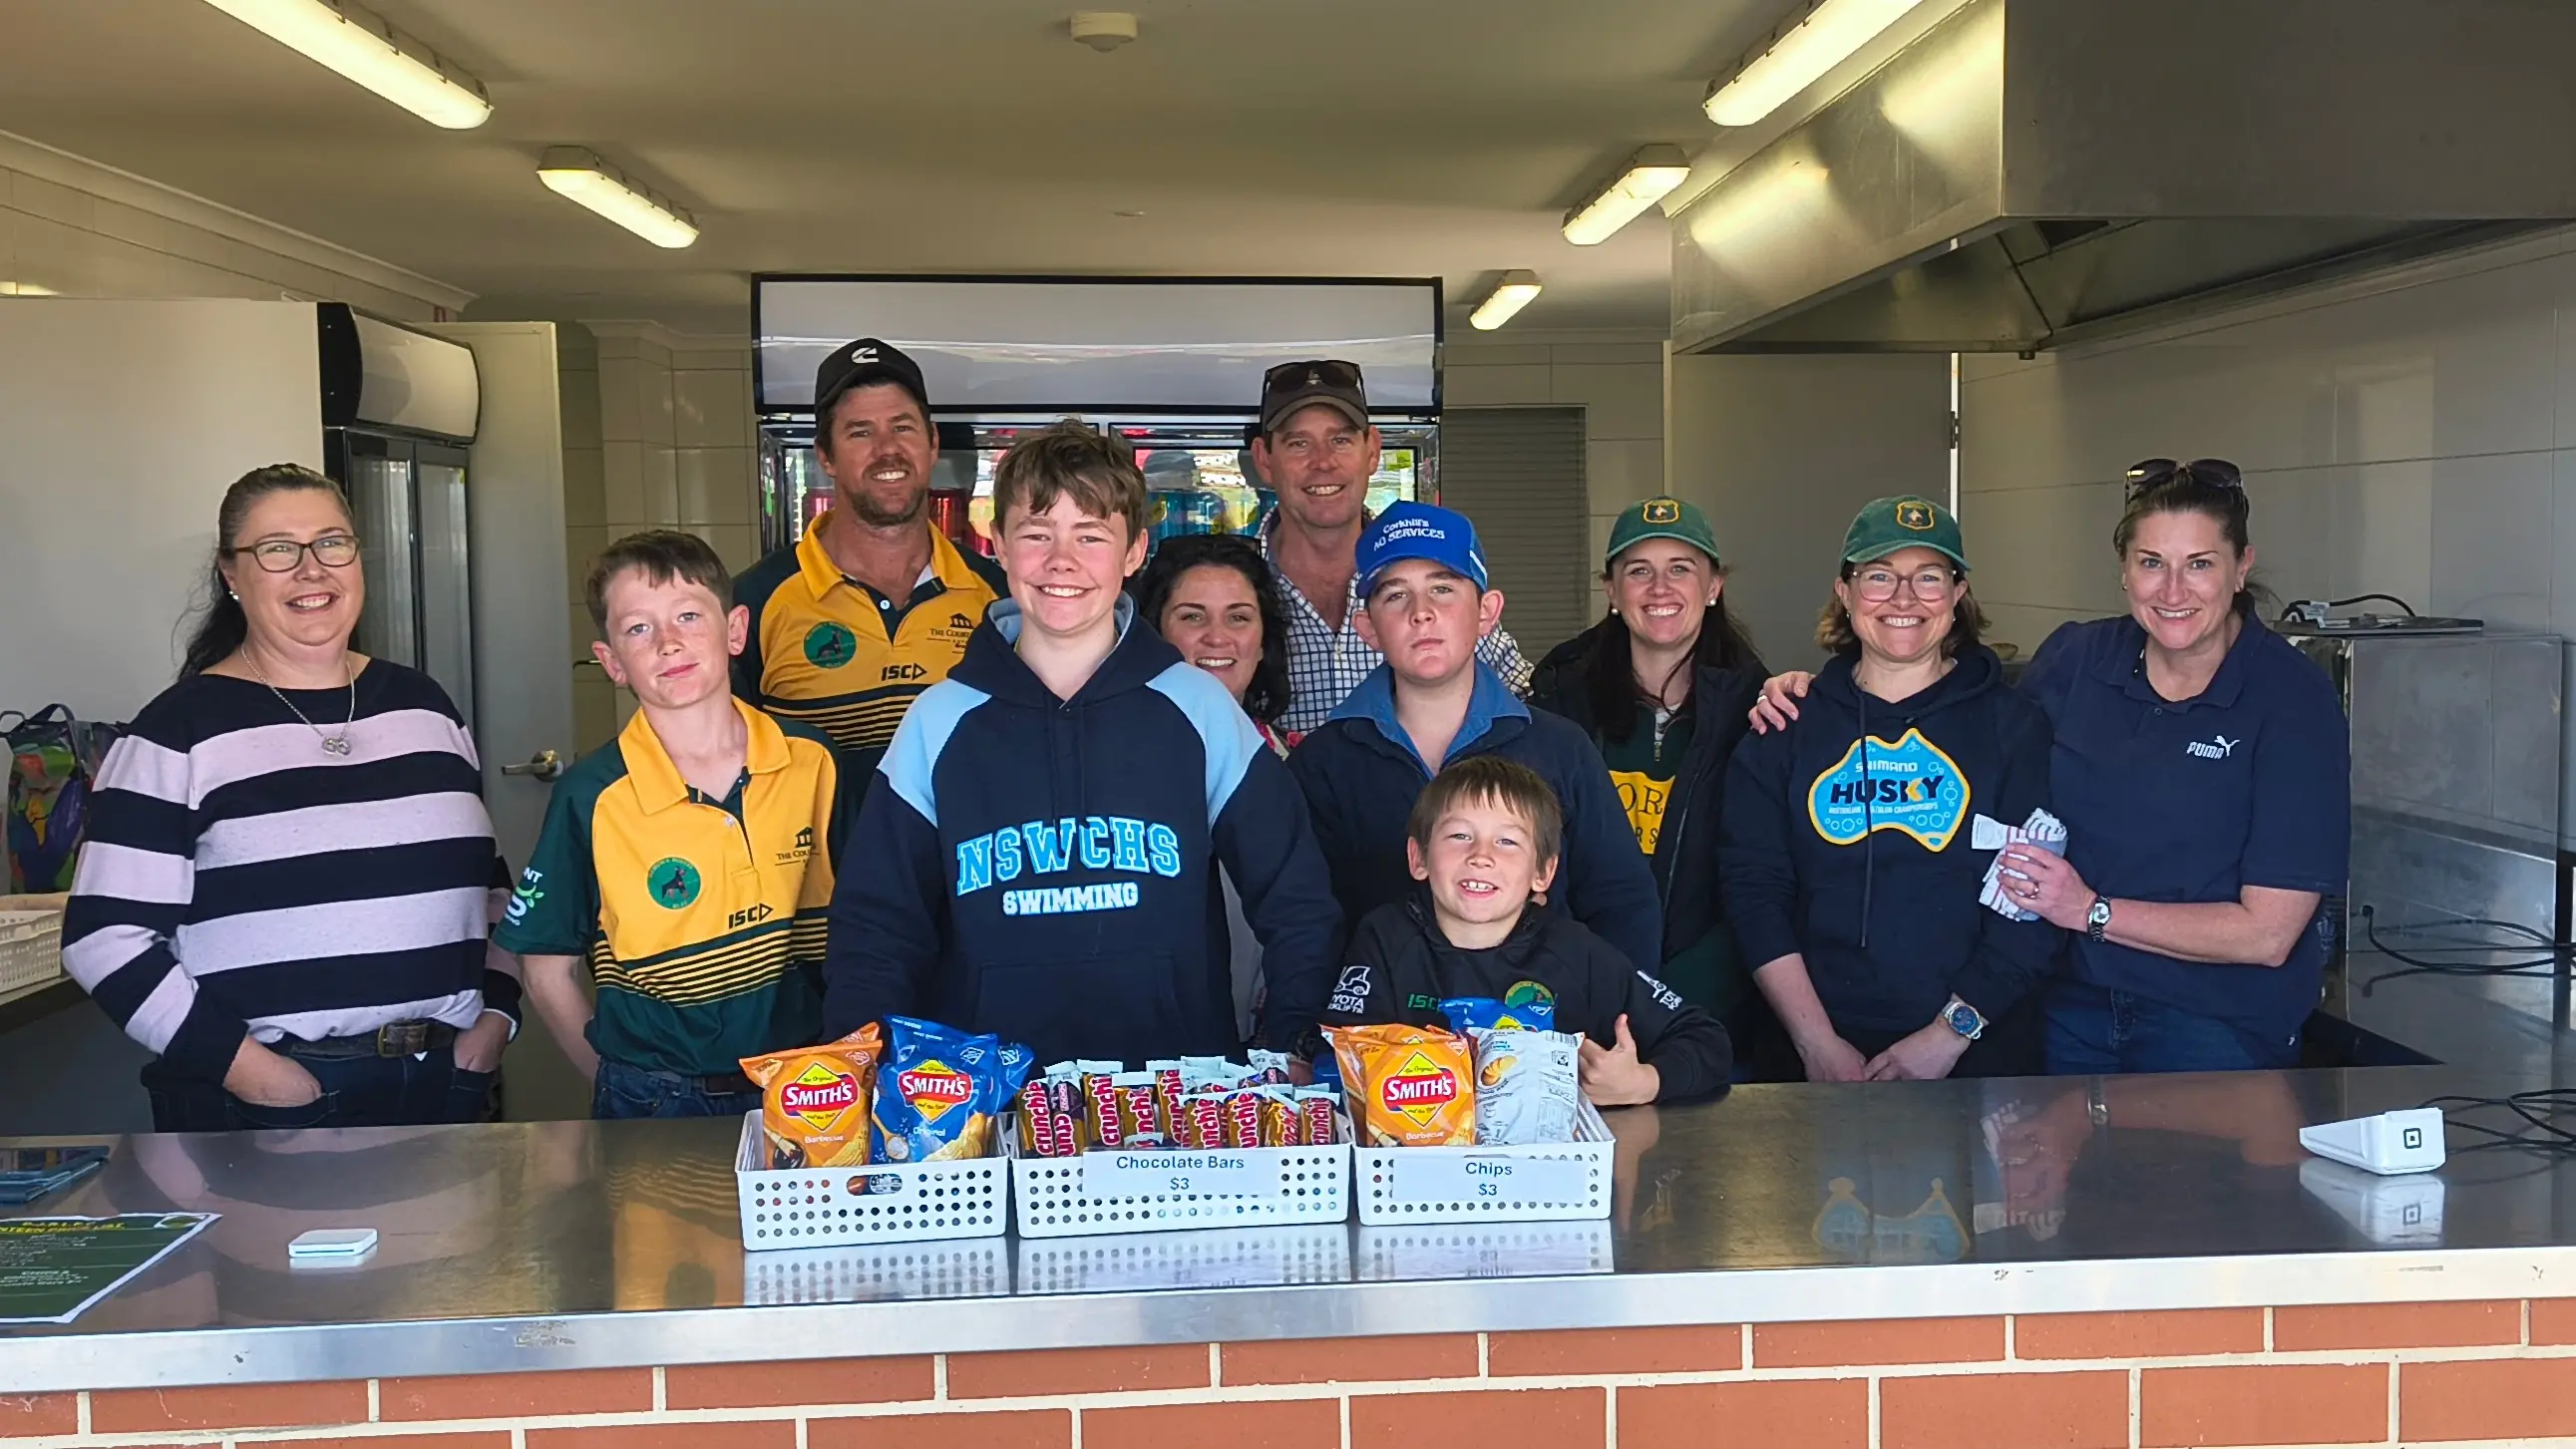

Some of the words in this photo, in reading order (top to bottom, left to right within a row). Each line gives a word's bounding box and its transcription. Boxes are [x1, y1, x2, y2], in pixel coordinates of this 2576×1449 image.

[1387, 528, 1445, 543] SERVICES
[881, 663, 913, 681] ISC
[2186, 741, 2225, 760] PUMA
[1830, 775, 1945, 805] HUSKY
[956, 816, 1181, 897] NSWCHS
[1002, 882, 1139, 915] SWIMMING
[728, 905, 759, 929] ISC
[1331, 993, 1365, 1010] YOTA
[784, 1081, 854, 1106] SMITH'S
[902, 1074, 967, 1096] SMITH'S
[1385, 1074, 1453, 1101] SMITH'S
[1022, 1080, 1055, 1156] crunchie
[1088, 1076, 1121, 1146] crunchi
[1233, 1091, 1259, 1148] unchie
[1116, 1156, 1204, 1170] Chocolate
[1208, 1155, 1246, 1170] Bars
[1465, 1162, 1513, 1178] Chips
[1170, 1177, 1190, 1191] $3
[1478, 1183, 1498, 1196] $3
